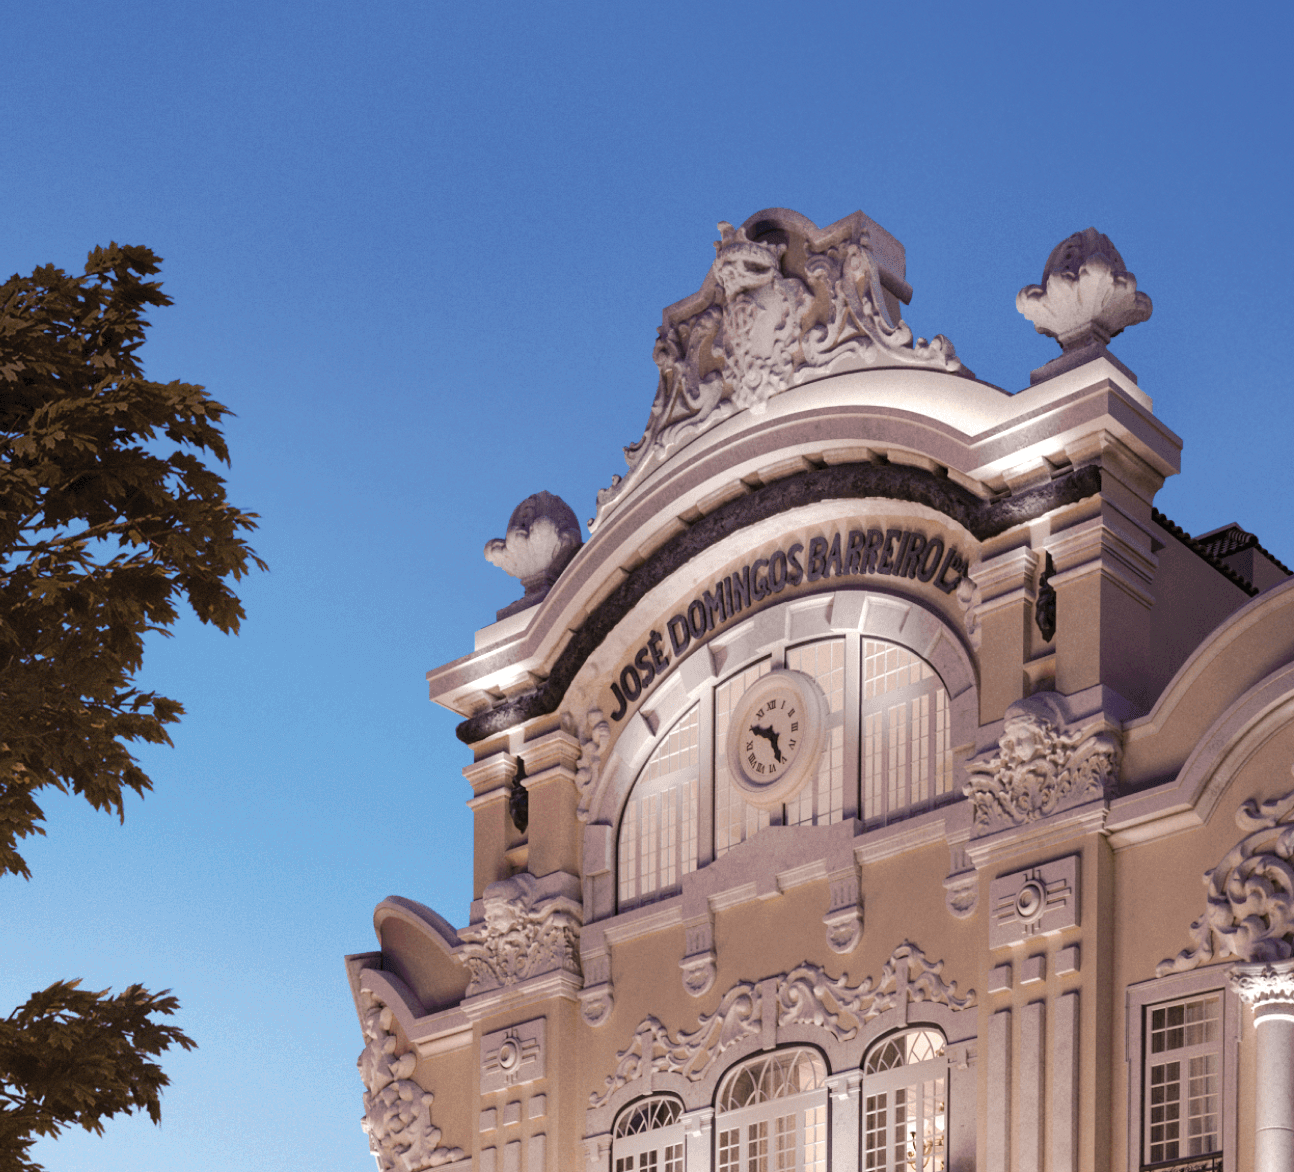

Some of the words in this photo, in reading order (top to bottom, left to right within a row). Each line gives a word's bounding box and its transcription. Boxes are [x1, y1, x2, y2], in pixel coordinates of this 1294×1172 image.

[609, 630, 670, 722] JOSÉ
[666, 543, 805, 657] DOMINGOS
[807, 528, 945, 583] BARREIRO
[766, 699, 777, 711] XII
[791, 721, 799, 732] III
